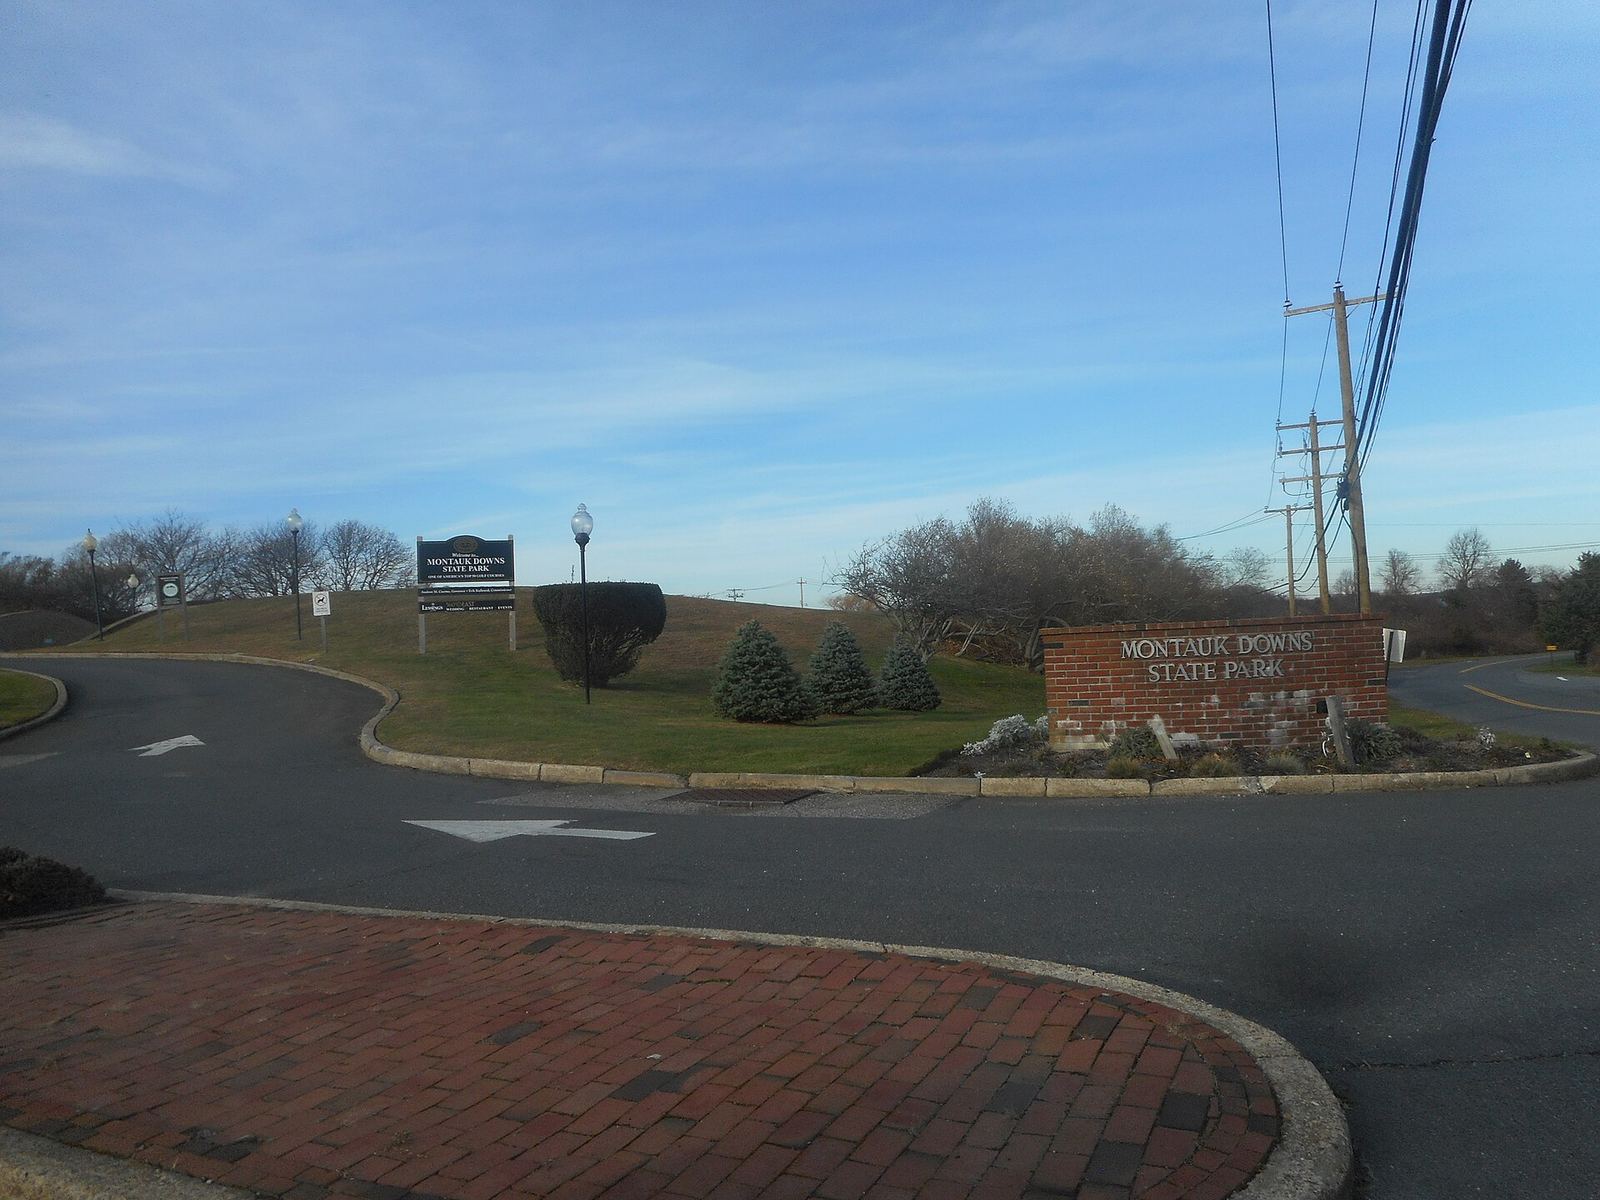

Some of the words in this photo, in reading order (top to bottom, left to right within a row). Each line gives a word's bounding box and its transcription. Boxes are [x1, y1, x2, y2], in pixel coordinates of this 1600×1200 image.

[1121, 636, 1230, 659] MONTAUK
[1238, 632, 1313, 655] DOWNS
[1149, 660, 1217, 682] STATE
[1224, 658, 1284, 679] PARK
